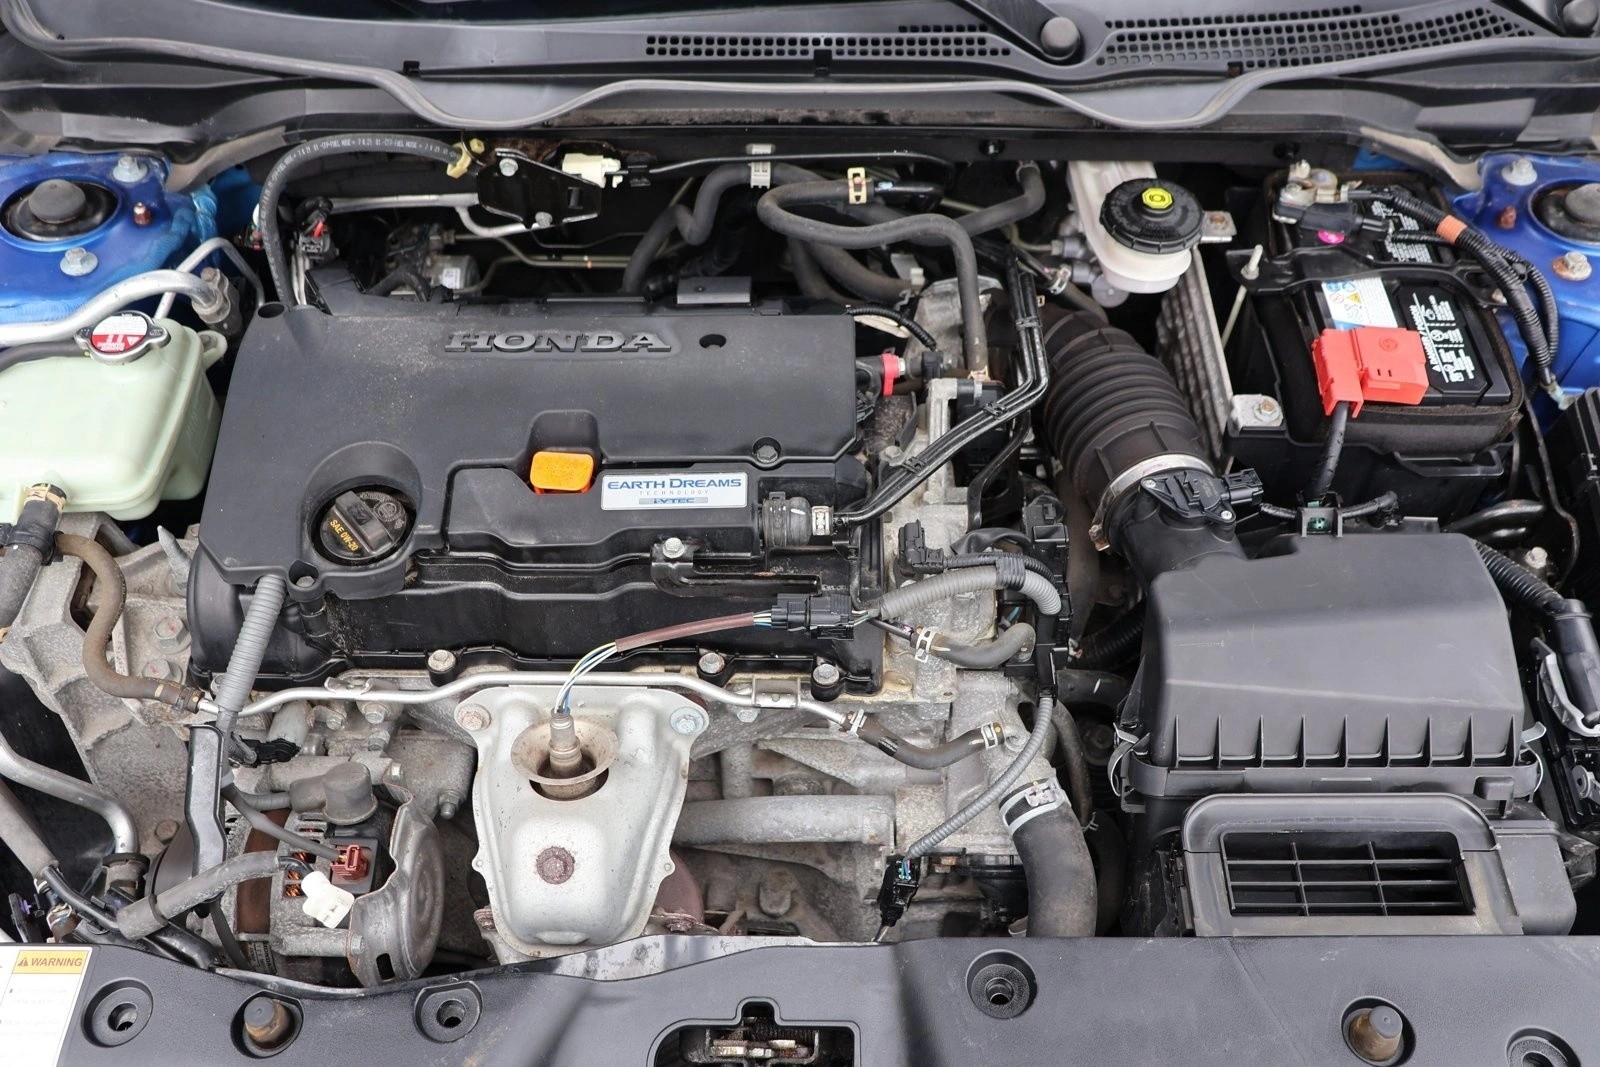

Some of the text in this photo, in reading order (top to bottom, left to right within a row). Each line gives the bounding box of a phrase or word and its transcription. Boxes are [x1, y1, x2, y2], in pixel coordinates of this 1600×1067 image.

[445, 331, 672, 352] HONDA
[607, 478, 742, 490] EARTH DREAMS
[330, 519, 359, 551] SAE 0W-20
[31, 957, 83, 967] WARNING
